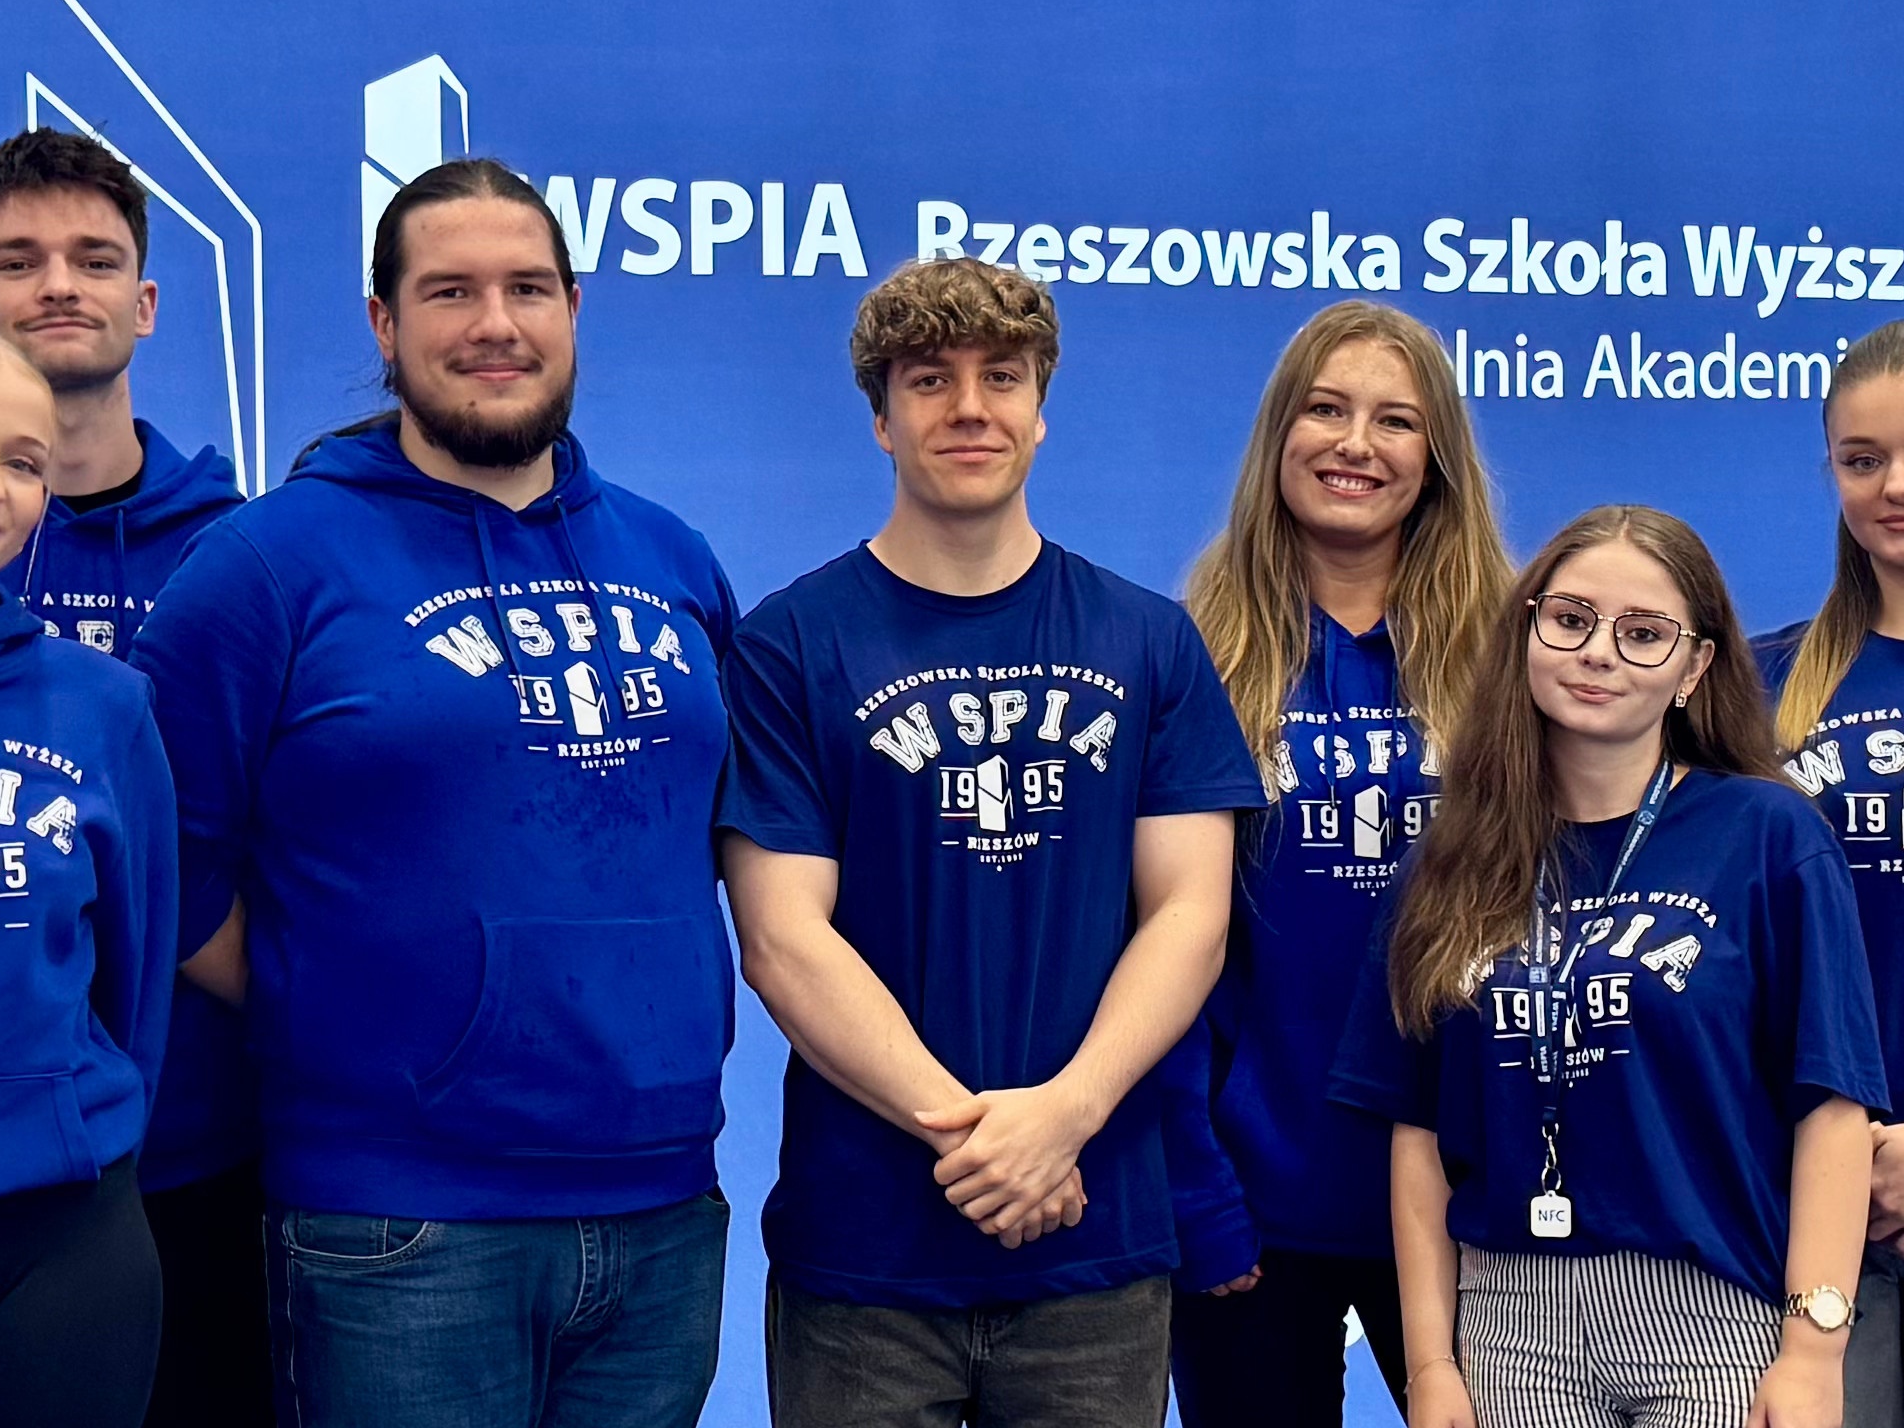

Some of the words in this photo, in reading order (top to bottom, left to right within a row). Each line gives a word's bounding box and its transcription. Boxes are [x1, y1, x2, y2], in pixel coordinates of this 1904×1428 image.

[916, 200, 1401, 292] Rzeszowska
[1422, 216, 1668, 297] Szkoła
[425, 603, 691, 678] WSPIA
[511, 678, 557, 717] 19
[623, 671, 665, 712] 95
[854, 666, 972, 722] RZESZOWSKA
[1050, 663, 1126, 701] WYŻSZA
[557, 738, 642, 758] RZESZÓW
[869, 689, 1118, 774] WSPIA
[3, 739, 84, 785] WYŻSZA
[941, 771, 976, 809] 19
[1023, 765, 1065, 805] 95
[1301, 803, 1339, 840] 19
[1846, 797, 1886, 834] 19
[1648, 891, 1719, 928] WYŻSZA
[1493, 992, 1530, 1030] 19
[1586, 978, 1631, 1020] 95
[1537, 1209, 1566, 1223] NFC
